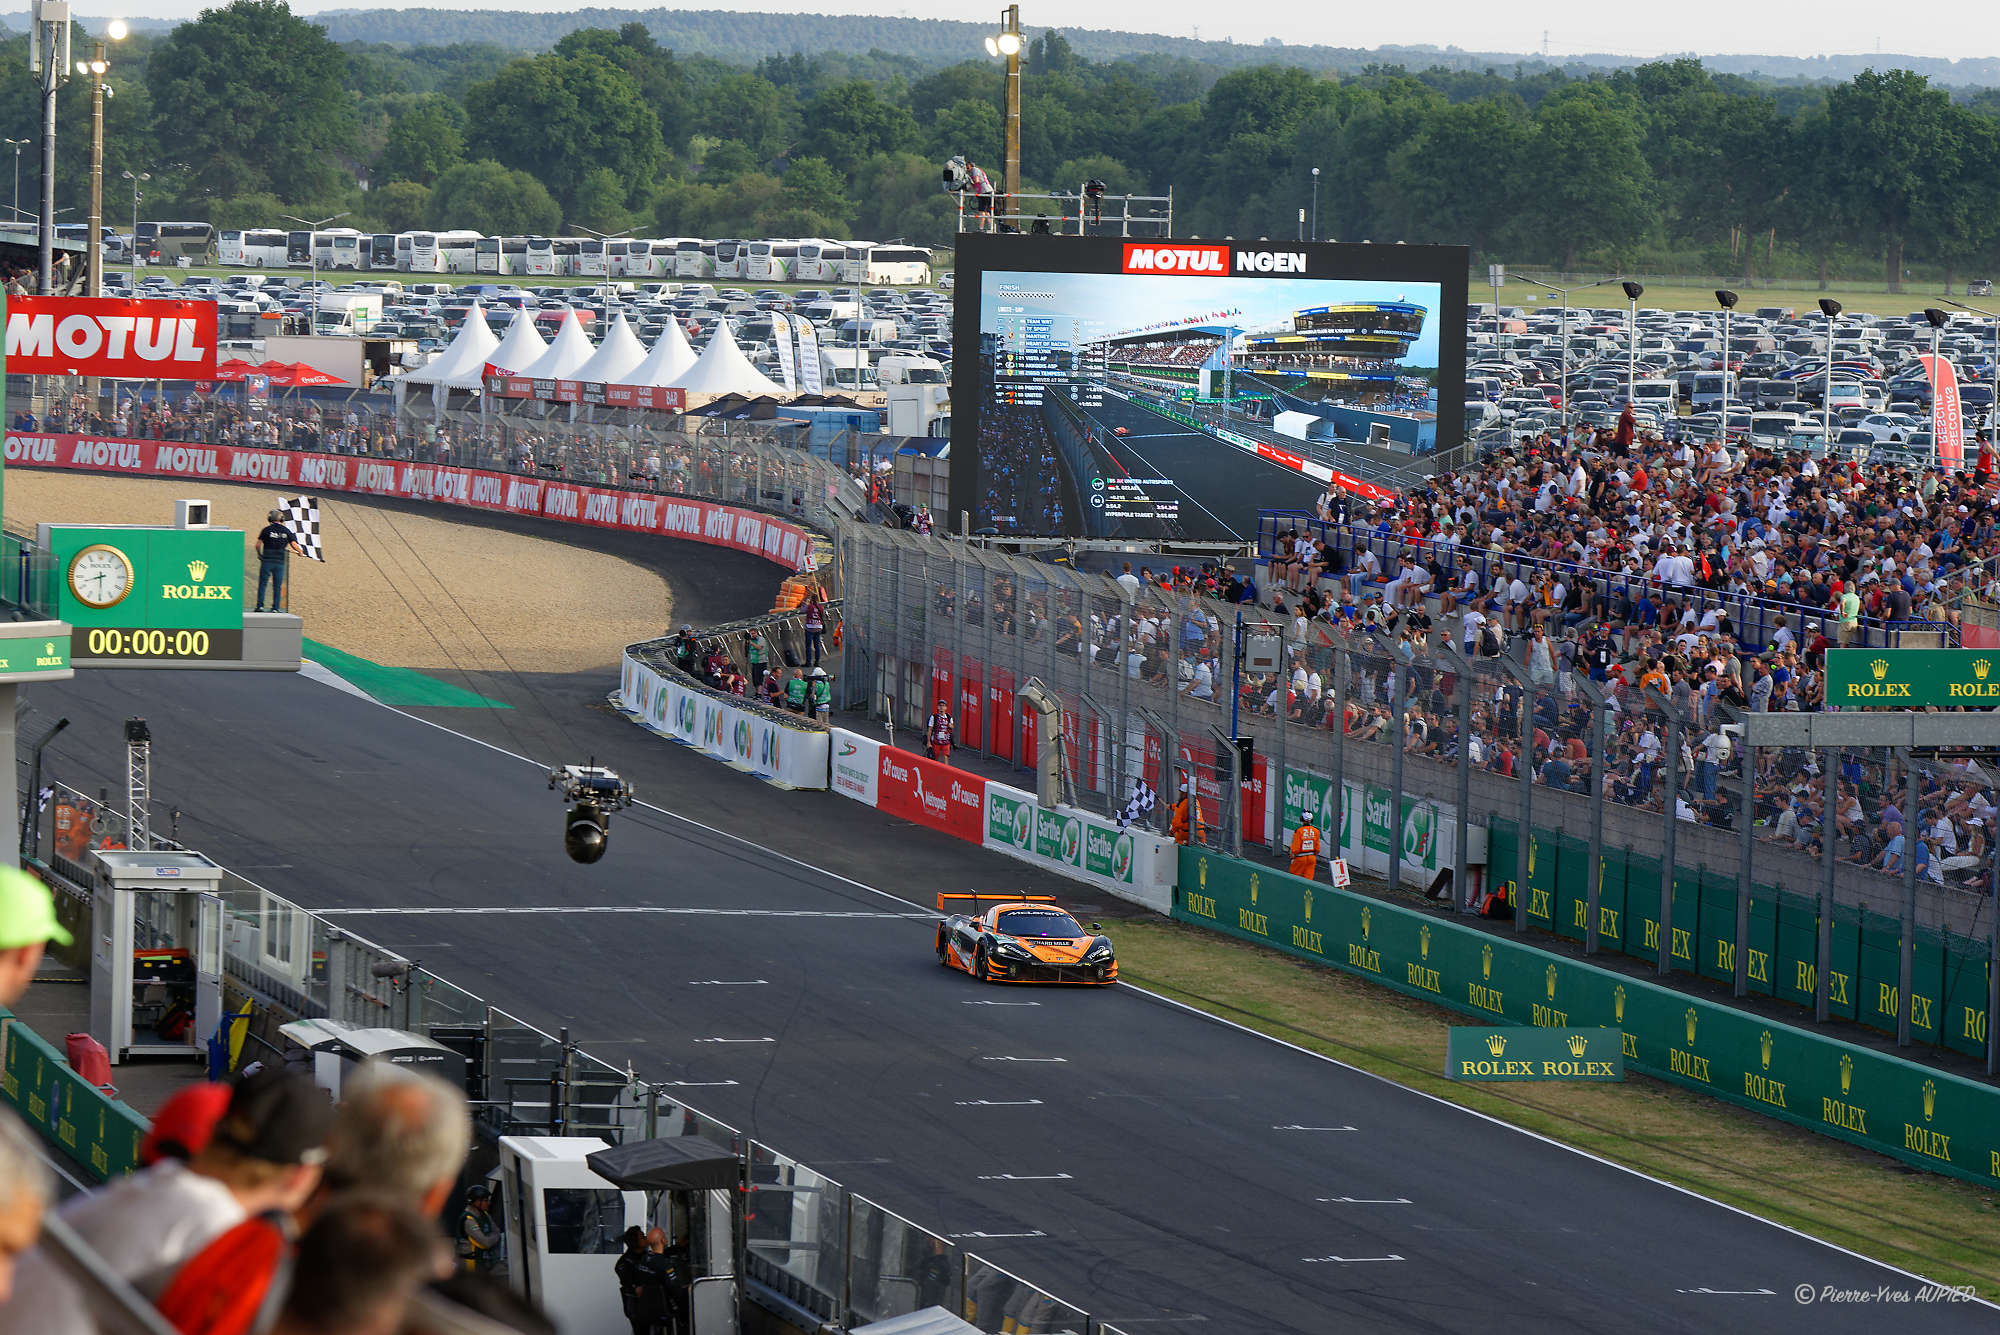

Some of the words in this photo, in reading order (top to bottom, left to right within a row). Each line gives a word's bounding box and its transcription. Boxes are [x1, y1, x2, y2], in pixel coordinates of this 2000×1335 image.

[1128, 249, 1223, 271] MOTUL
[1236, 251, 1306, 273] NGEN
[6, 313, 205, 362] MOTUL
[491, 379, 502, 392] BAR
[665, 390, 678, 406] BAR
[4, 436, 57, 462] OTUL
[72, 440, 141, 468] MOTUL
[155, 446, 219, 474] MOTUL
[230, 452, 290, 480] MOTUL
[300, 458, 346, 485] MOTUL
[355, 463, 395, 490] MOTUL
[400, 467, 434, 494] MOTUL
[434, 471, 467, 499] MOTUL
[472, 476, 501, 504] MOTUL
[506, 481, 539, 511] MOTUL
[545, 488, 578, 518] MOTUL
[584, 494, 618, 524] MOTUL
[622, 498, 657, 528] MOTUL
[664, 504, 700, 534] MOTUL
[162, 585, 232, 600] ROLEX
[88, 629, 209, 655] 00:00:00
[36, 657, 63, 666] ROLEX
[1847, 683, 1911, 697] ROLEX
[1949, 683, 2000, 696] ROLE
[892, 766, 908, 782] course
[962, 790, 979, 808] course
[992, 798, 1012, 827] Sarthe
[1038, 814, 1060, 842] Sarthe
[1088, 829, 1112, 859] Sarthe
[1188, 892, 1216, 919] ROLEX
[1239, 908, 1268, 936] ROLEX
[1292, 925, 1323, 954] ROLEX
[1644, 919, 1691, 960] ROEX
[1349, 944, 1381, 973] ROLEX
[1718, 940, 1768, 982] ROEX
[1408, 963, 1440, 993] ROLEX
[1796, 961, 1848, 1005] ROEX
[1469, 982, 1503, 1014] ROLEX
[1878, 983, 1932, 1029] ROEX
[1462, 1062, 1534, 1076] ROLEX
[1542, 1062, 1615, 1076] ROLEX
[1670, 1048, 1710, 1083] ROLEX
[1744, 1072, 1786, 1108] ROLEX
[1823, 1097, 1867, 1134] ROLEX
[1904, 1123, 1951, 1161] ROLEX
